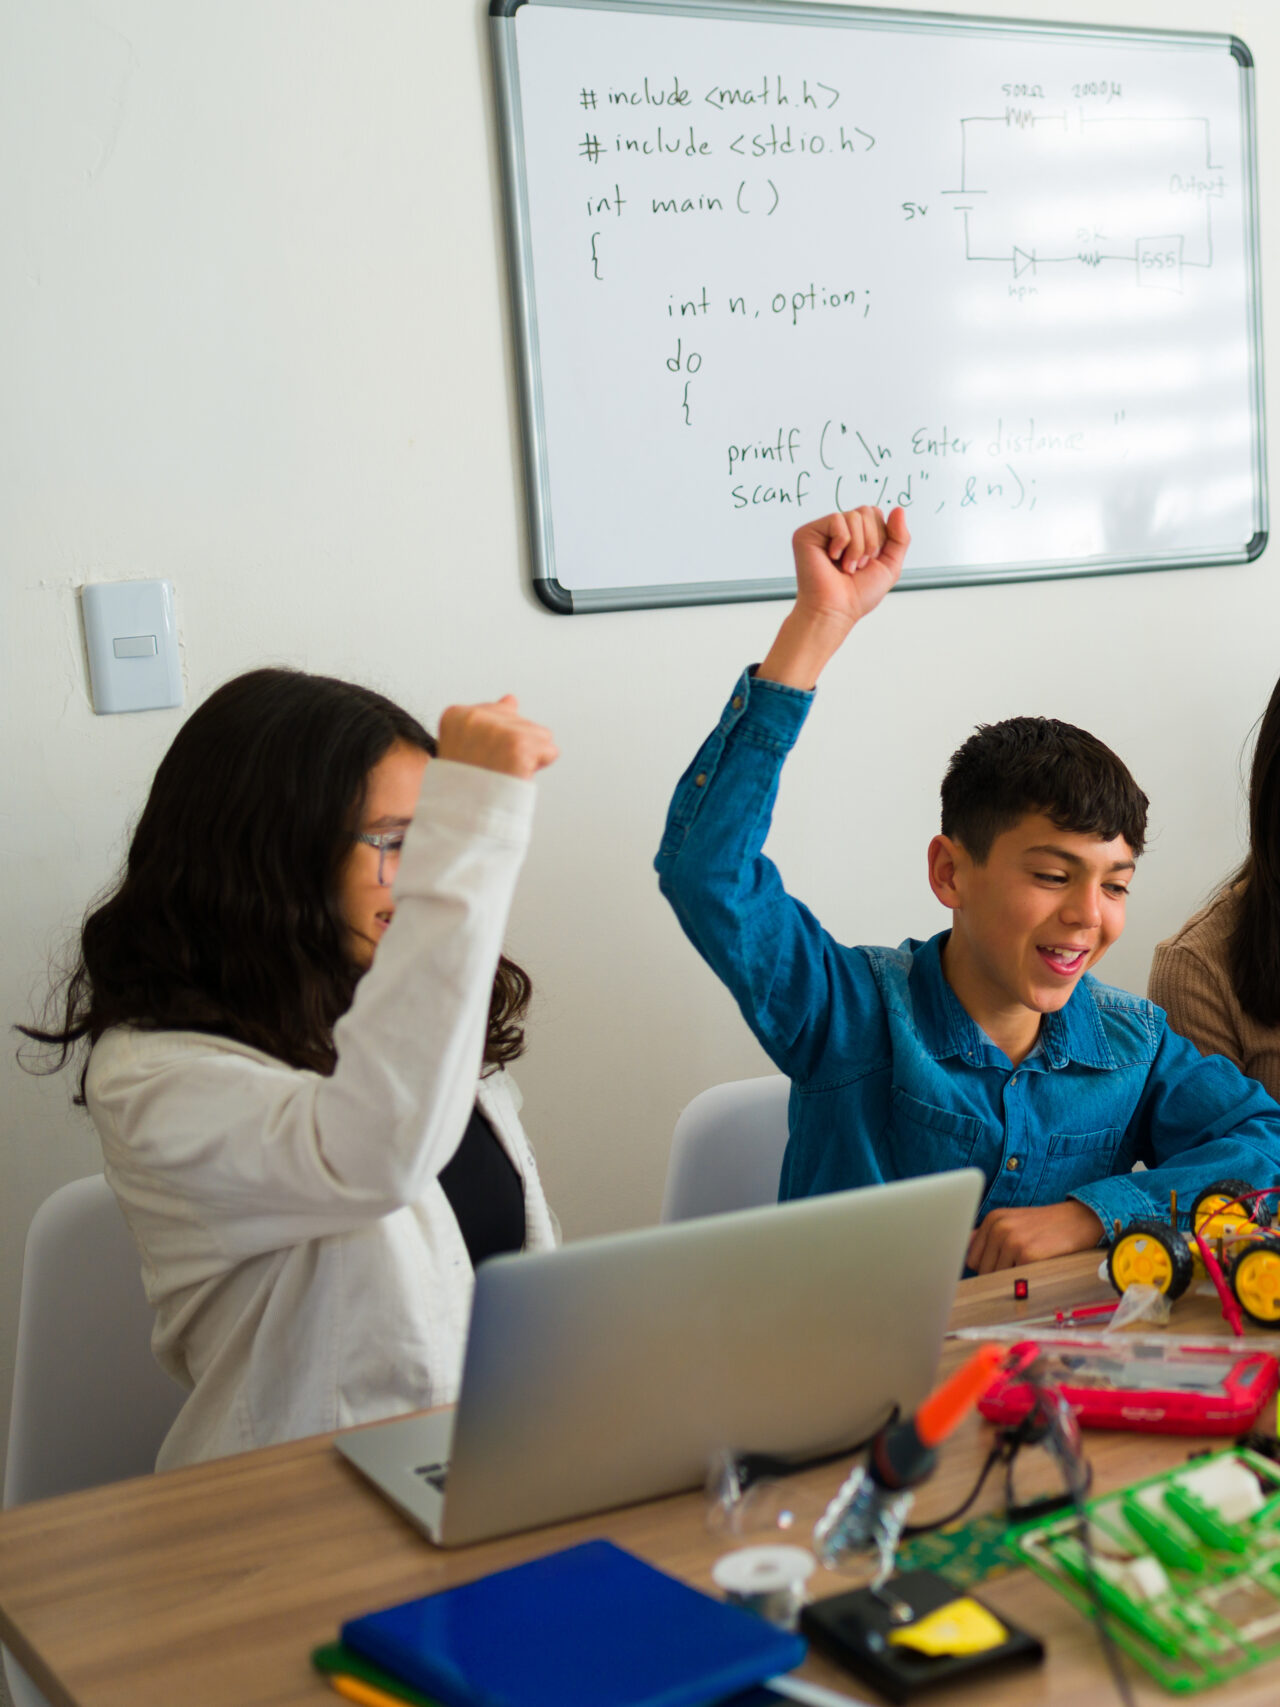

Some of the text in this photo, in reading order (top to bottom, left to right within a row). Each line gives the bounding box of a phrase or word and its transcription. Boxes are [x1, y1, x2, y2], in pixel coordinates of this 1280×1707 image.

[704, 75, 841, 110] <math.h>
[729, 124, 877, 157] <stdio.h>
[586, 184, 627, 217] int
[591, 231, 604, 281] {
[668, 286, 711, 317] int
[771, 283, 871, 326] option;
[666, 337, 703, 374] do
[682, 380, 693, 426] {
[728, 427, 801, 476] printf
[911, 425, 973, 457] Enter
[731, 470, 812, 509] scanf
